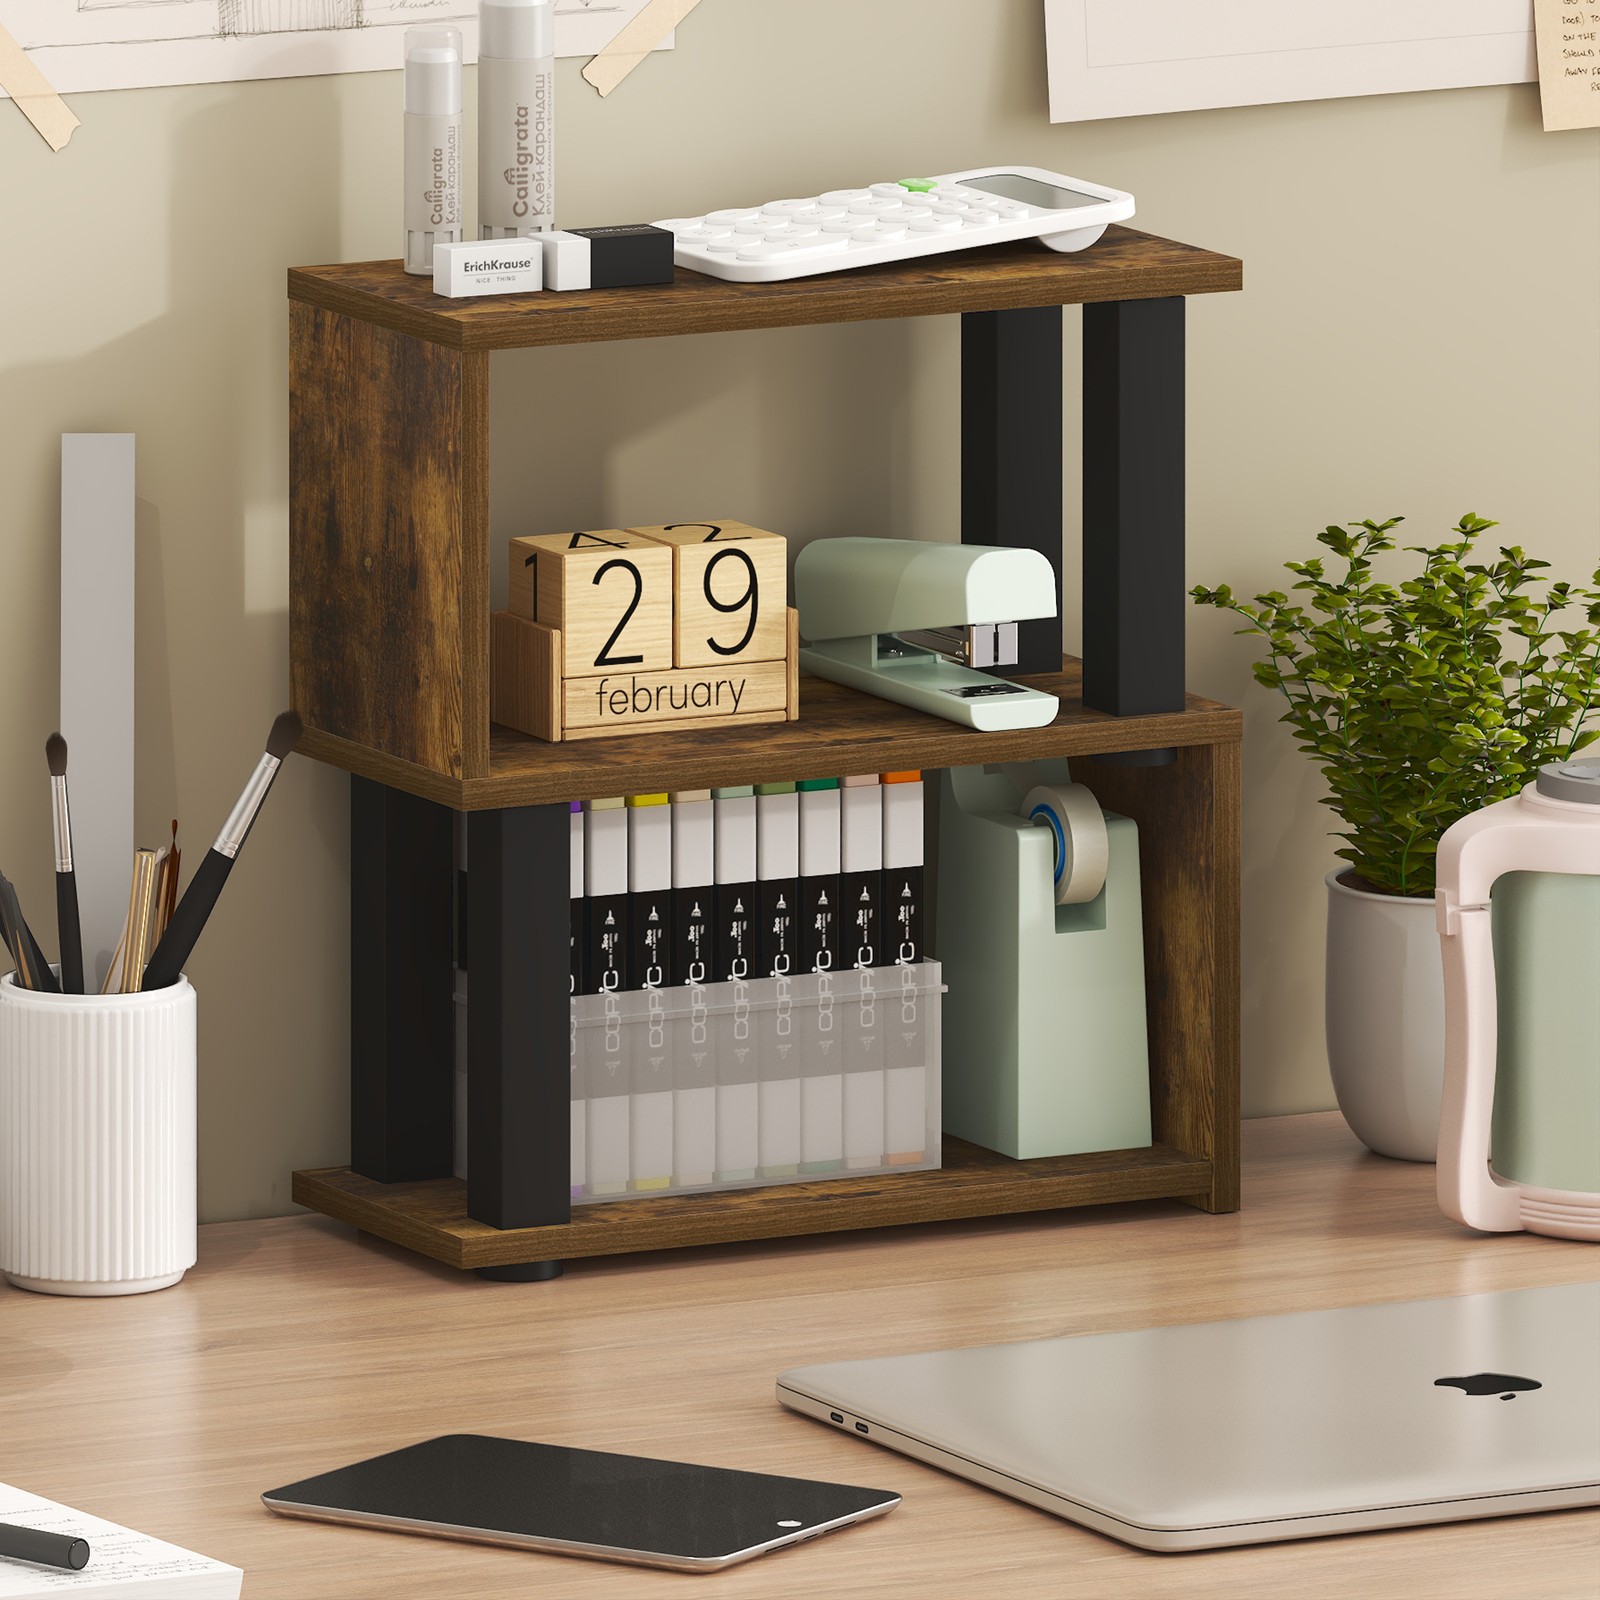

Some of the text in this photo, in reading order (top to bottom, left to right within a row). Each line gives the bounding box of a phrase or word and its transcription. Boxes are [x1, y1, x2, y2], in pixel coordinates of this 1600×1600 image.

[1577, 32, 1597, 41] THE
[445, 126, 457, 224] Клей-карандаш
[512, 106, 533, 217] Calligrata
[532, 74, 547, 216] Клей-карандаш
[430, 147, 447, 225] Calligrata
[463, 257, 532, 273] ErichKrause
[496, 274, 516, 282] THING
[524, 552, 538, 622] 1
[591, 548, 759, 667] 2 9
[595, 676, 746, 717] february
